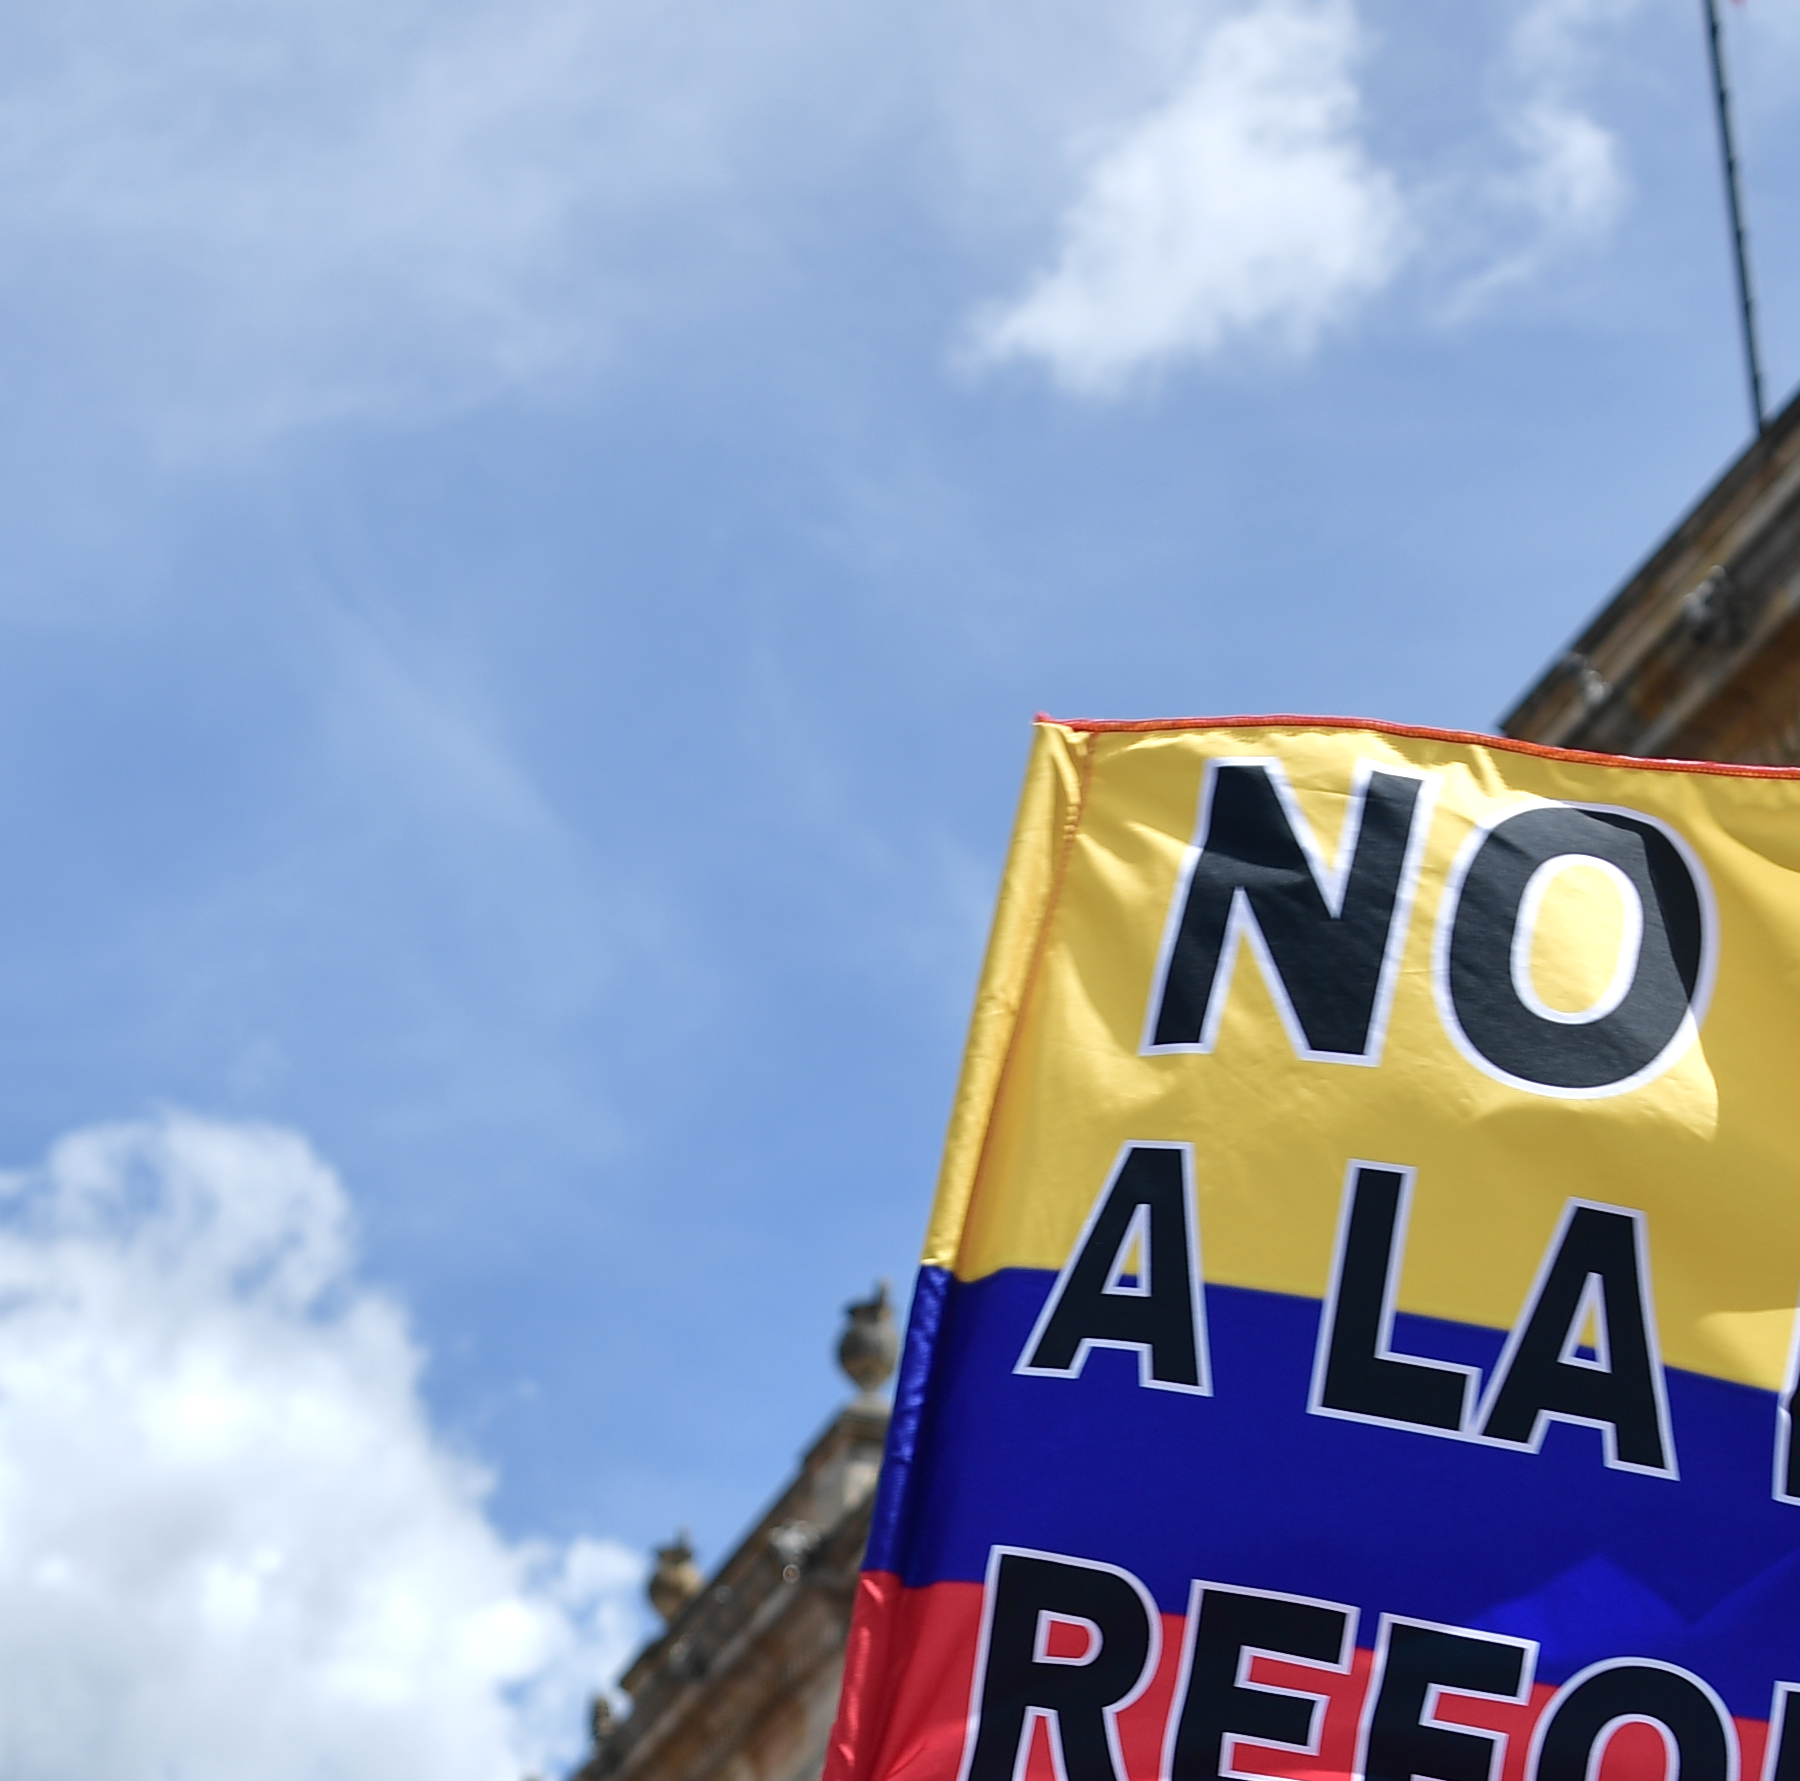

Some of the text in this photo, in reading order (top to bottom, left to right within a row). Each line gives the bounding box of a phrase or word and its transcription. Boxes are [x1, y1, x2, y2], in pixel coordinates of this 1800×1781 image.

[1143, 758, 1712, 1097] NO
[1018, 1142, 1210, 1394] A
[1308, 1160, 1678, 1478] LA
